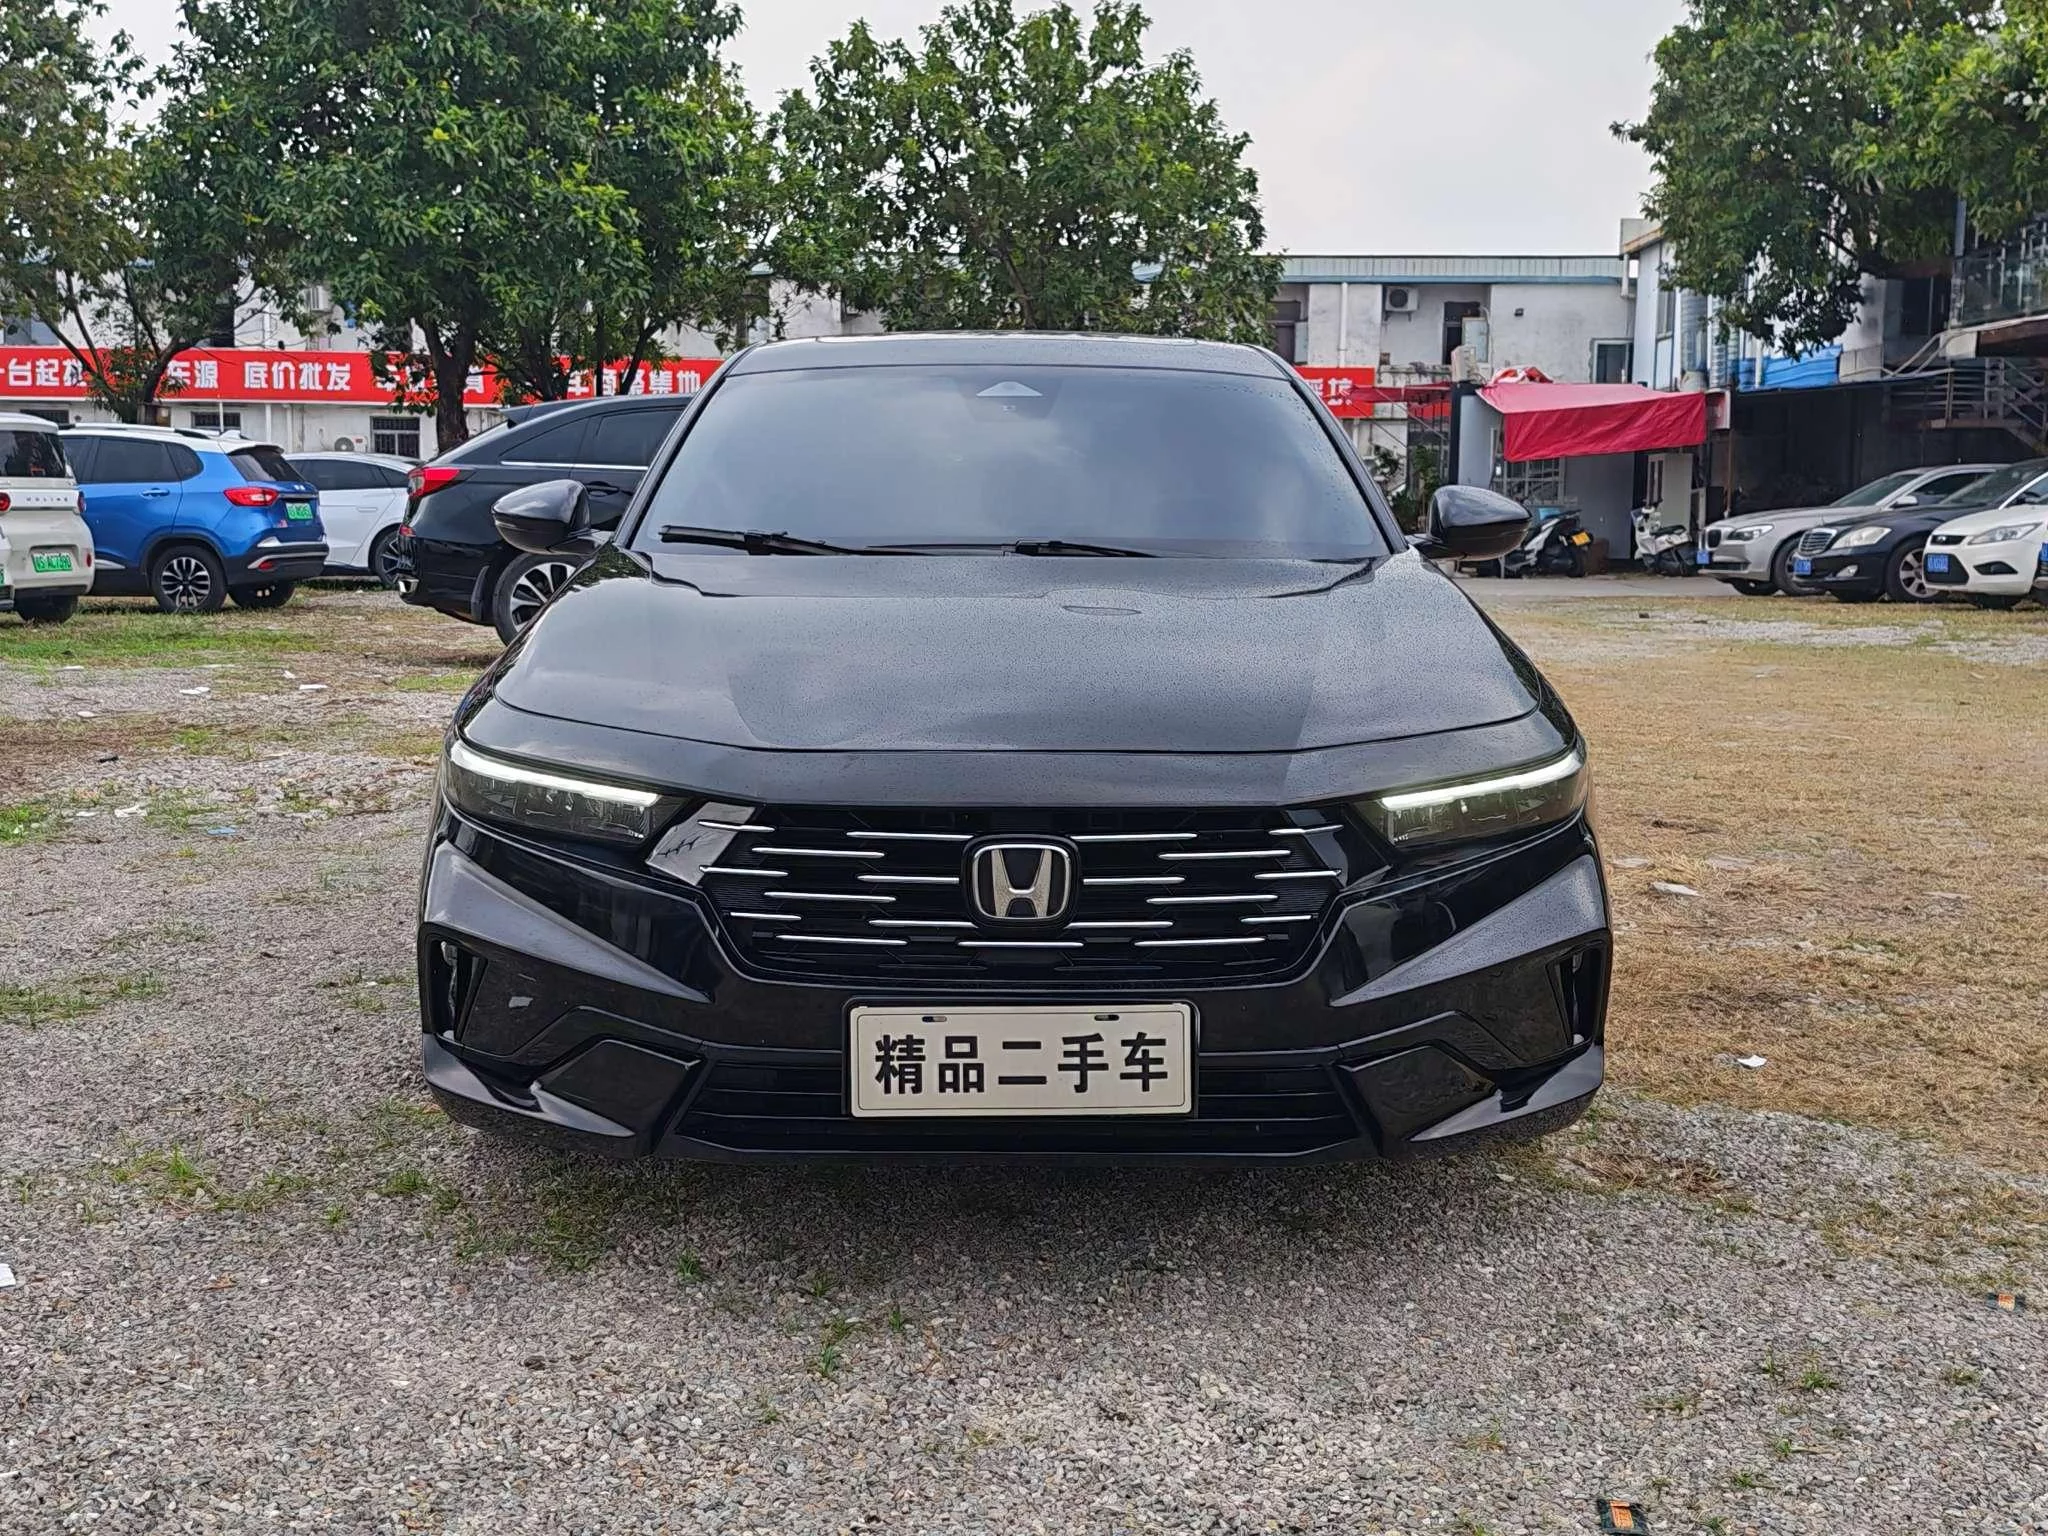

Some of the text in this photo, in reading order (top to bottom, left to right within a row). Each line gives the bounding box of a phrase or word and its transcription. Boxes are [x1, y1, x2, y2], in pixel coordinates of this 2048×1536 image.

[0, 358, 87, 387] 台起批
[244, 361, 351, 390] 底价批发
[874, 1031, 1169, 1095] 精品二手车
